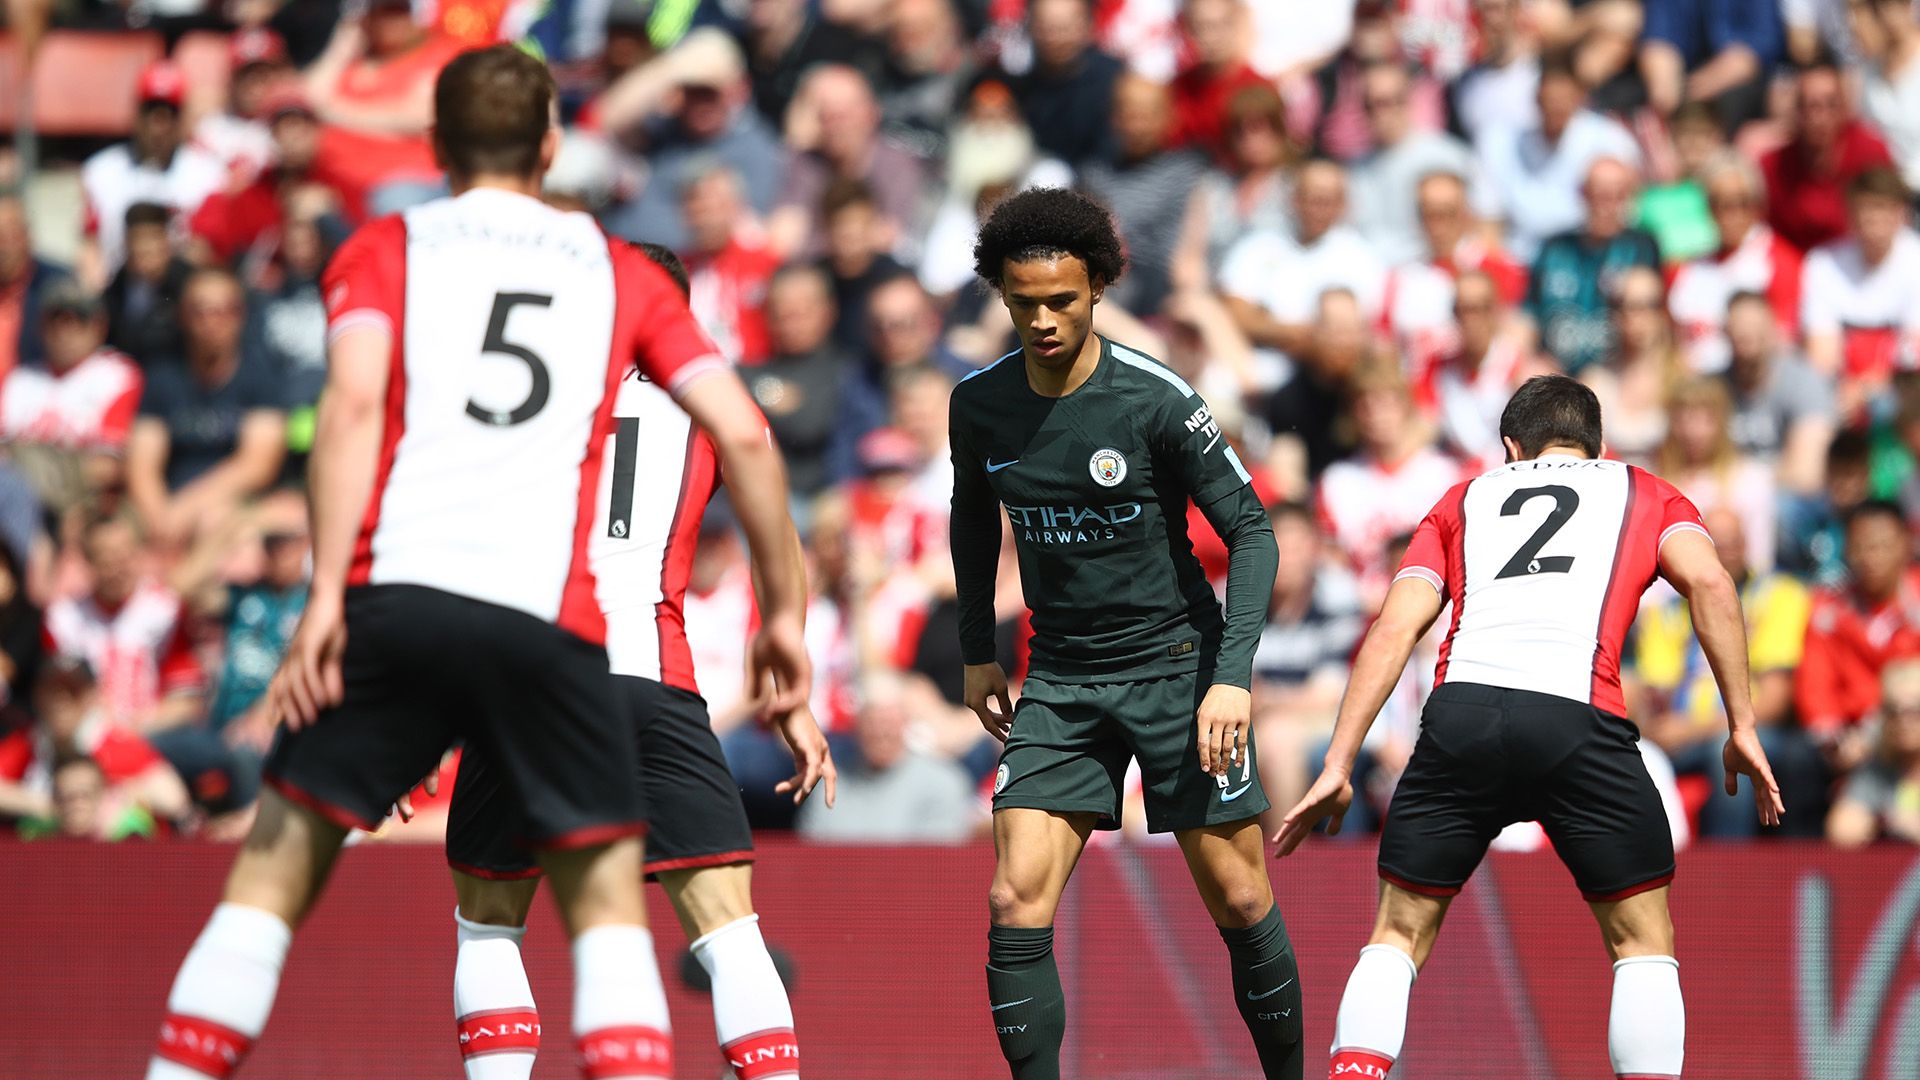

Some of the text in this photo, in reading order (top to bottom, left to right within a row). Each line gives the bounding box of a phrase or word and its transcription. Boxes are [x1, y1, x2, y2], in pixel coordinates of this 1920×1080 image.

[465, 292, 553, 427] 5
[1025, 528, 1115, 544] AIRWAYS
[1494, 484, 1580, 580] 2
[1257, 1008, 1291, 1021] CITY
[997, 1024, 1027, 1034] CITY
